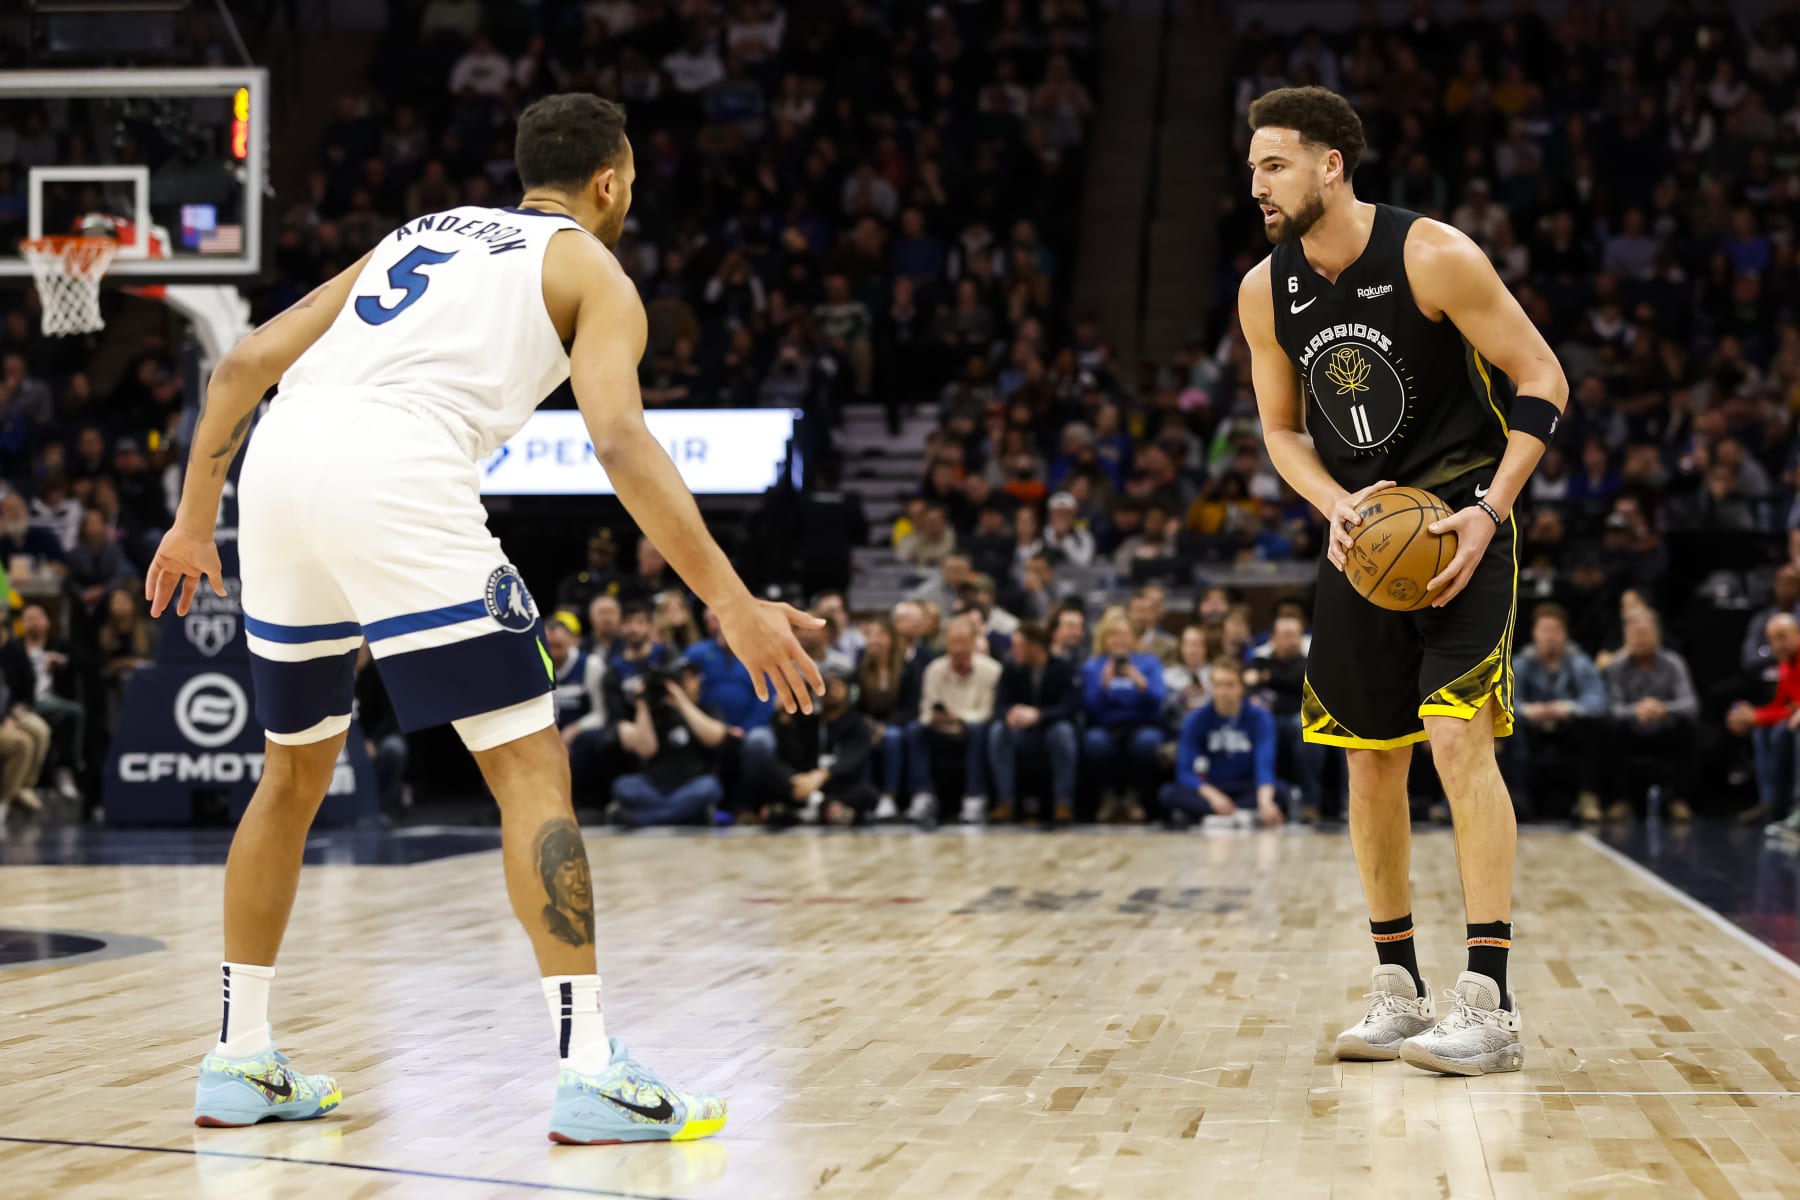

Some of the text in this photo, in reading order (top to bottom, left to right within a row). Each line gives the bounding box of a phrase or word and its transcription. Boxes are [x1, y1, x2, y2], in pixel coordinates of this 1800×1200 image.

[396, 216, 527, 255] ANDERSON
[355, 245, 460, 326] 5
[1287, 276, 1299, 293] 6
[1357, 284, 1393, 299] Rakuten
[1300, 323, 1393, 367] WARRIORS
[1350, 404, 1373, 444] 11
[118, 753, 265, 783] CFMOT
